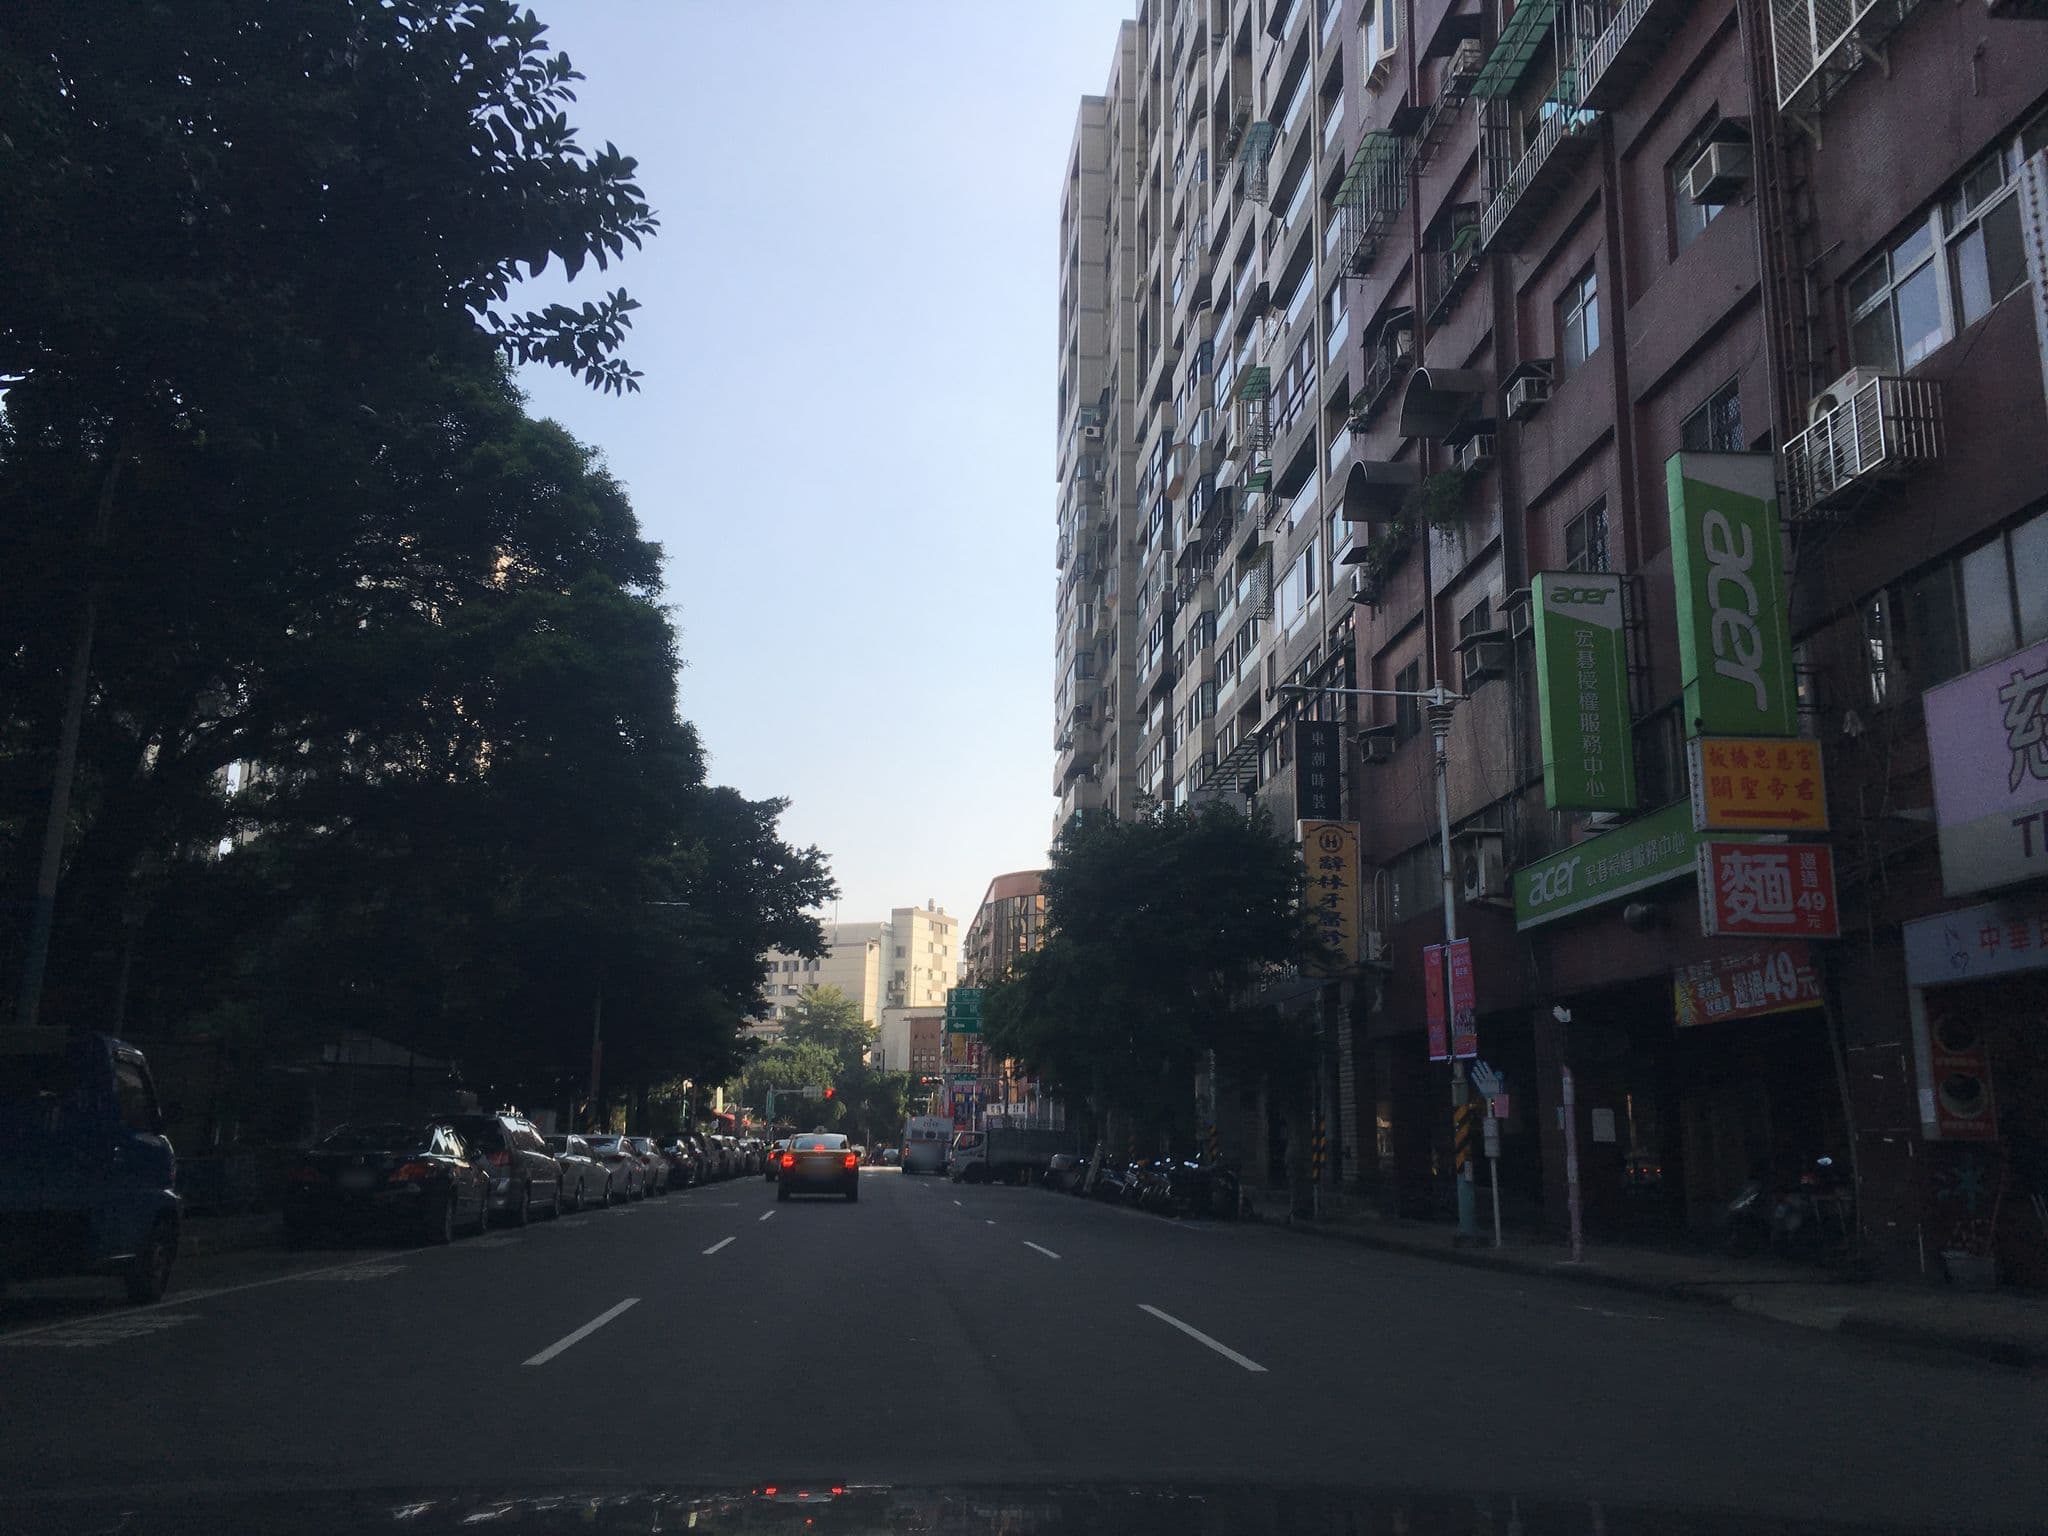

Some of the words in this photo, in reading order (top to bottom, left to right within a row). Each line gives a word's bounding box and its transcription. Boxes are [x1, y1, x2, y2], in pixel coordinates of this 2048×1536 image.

[1550, 586, 1616, 605] acer
[1703, 509, 1768, 712] acer
[1575, 630, 1605, 798] 宏碁授權服務中心
[1310, 730, 1327, 820] 東潮時裝
[1317, 855, 1349, 952] 林牙醫診
[1528, 855, 1582, 907] acer
[1719, 850, 1798, 925] 麵
[1977, 911, 2048, 959] 中華
